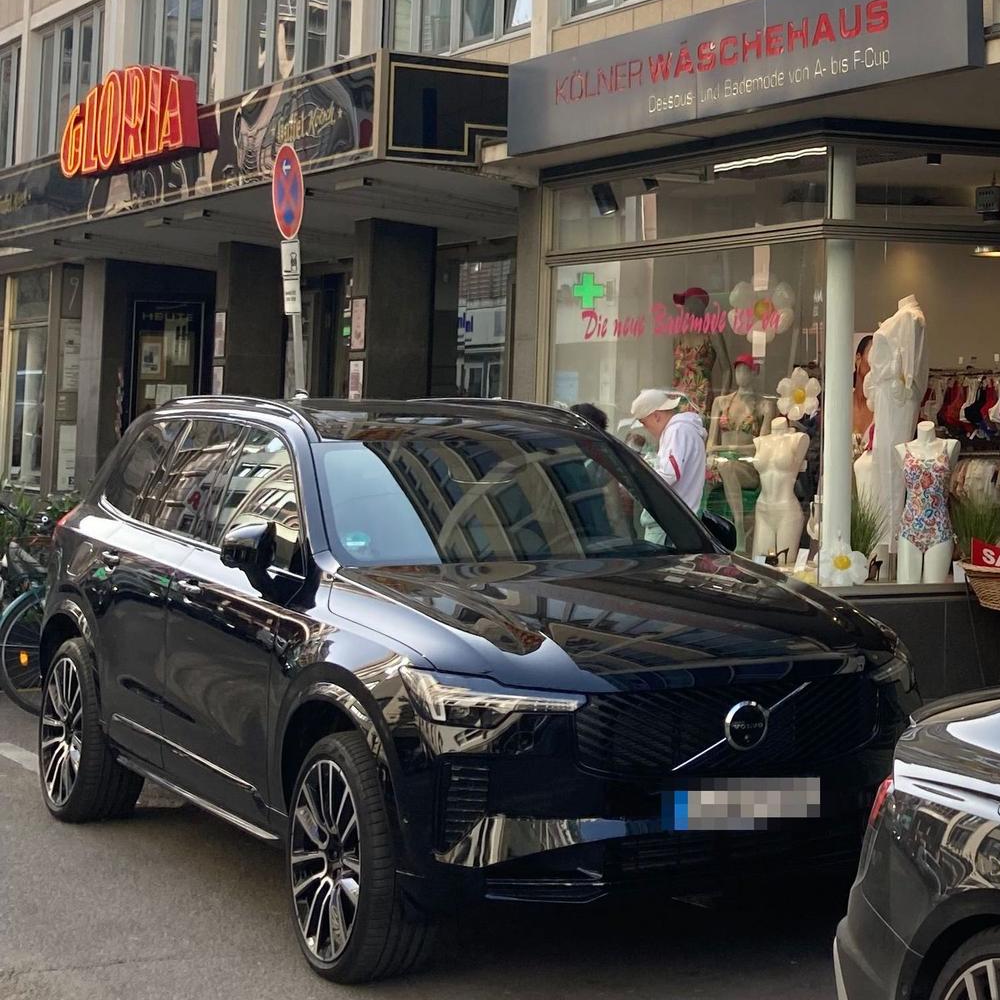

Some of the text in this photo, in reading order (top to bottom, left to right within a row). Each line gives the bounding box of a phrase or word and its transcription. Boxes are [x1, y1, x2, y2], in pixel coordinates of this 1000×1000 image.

[555, 60, 643, 105] KÖLNER
[648, 47, 890, 113] Dessous- und Bademode von A- bis F-Cup
[60, 66, 183, 178] GLORIA
[581, 310, 608, 340] Die
[614, 315, 645, 338] neue
[651, 302, 727, 336] Bademode
[733, 721, 764, 730] VOLVO
